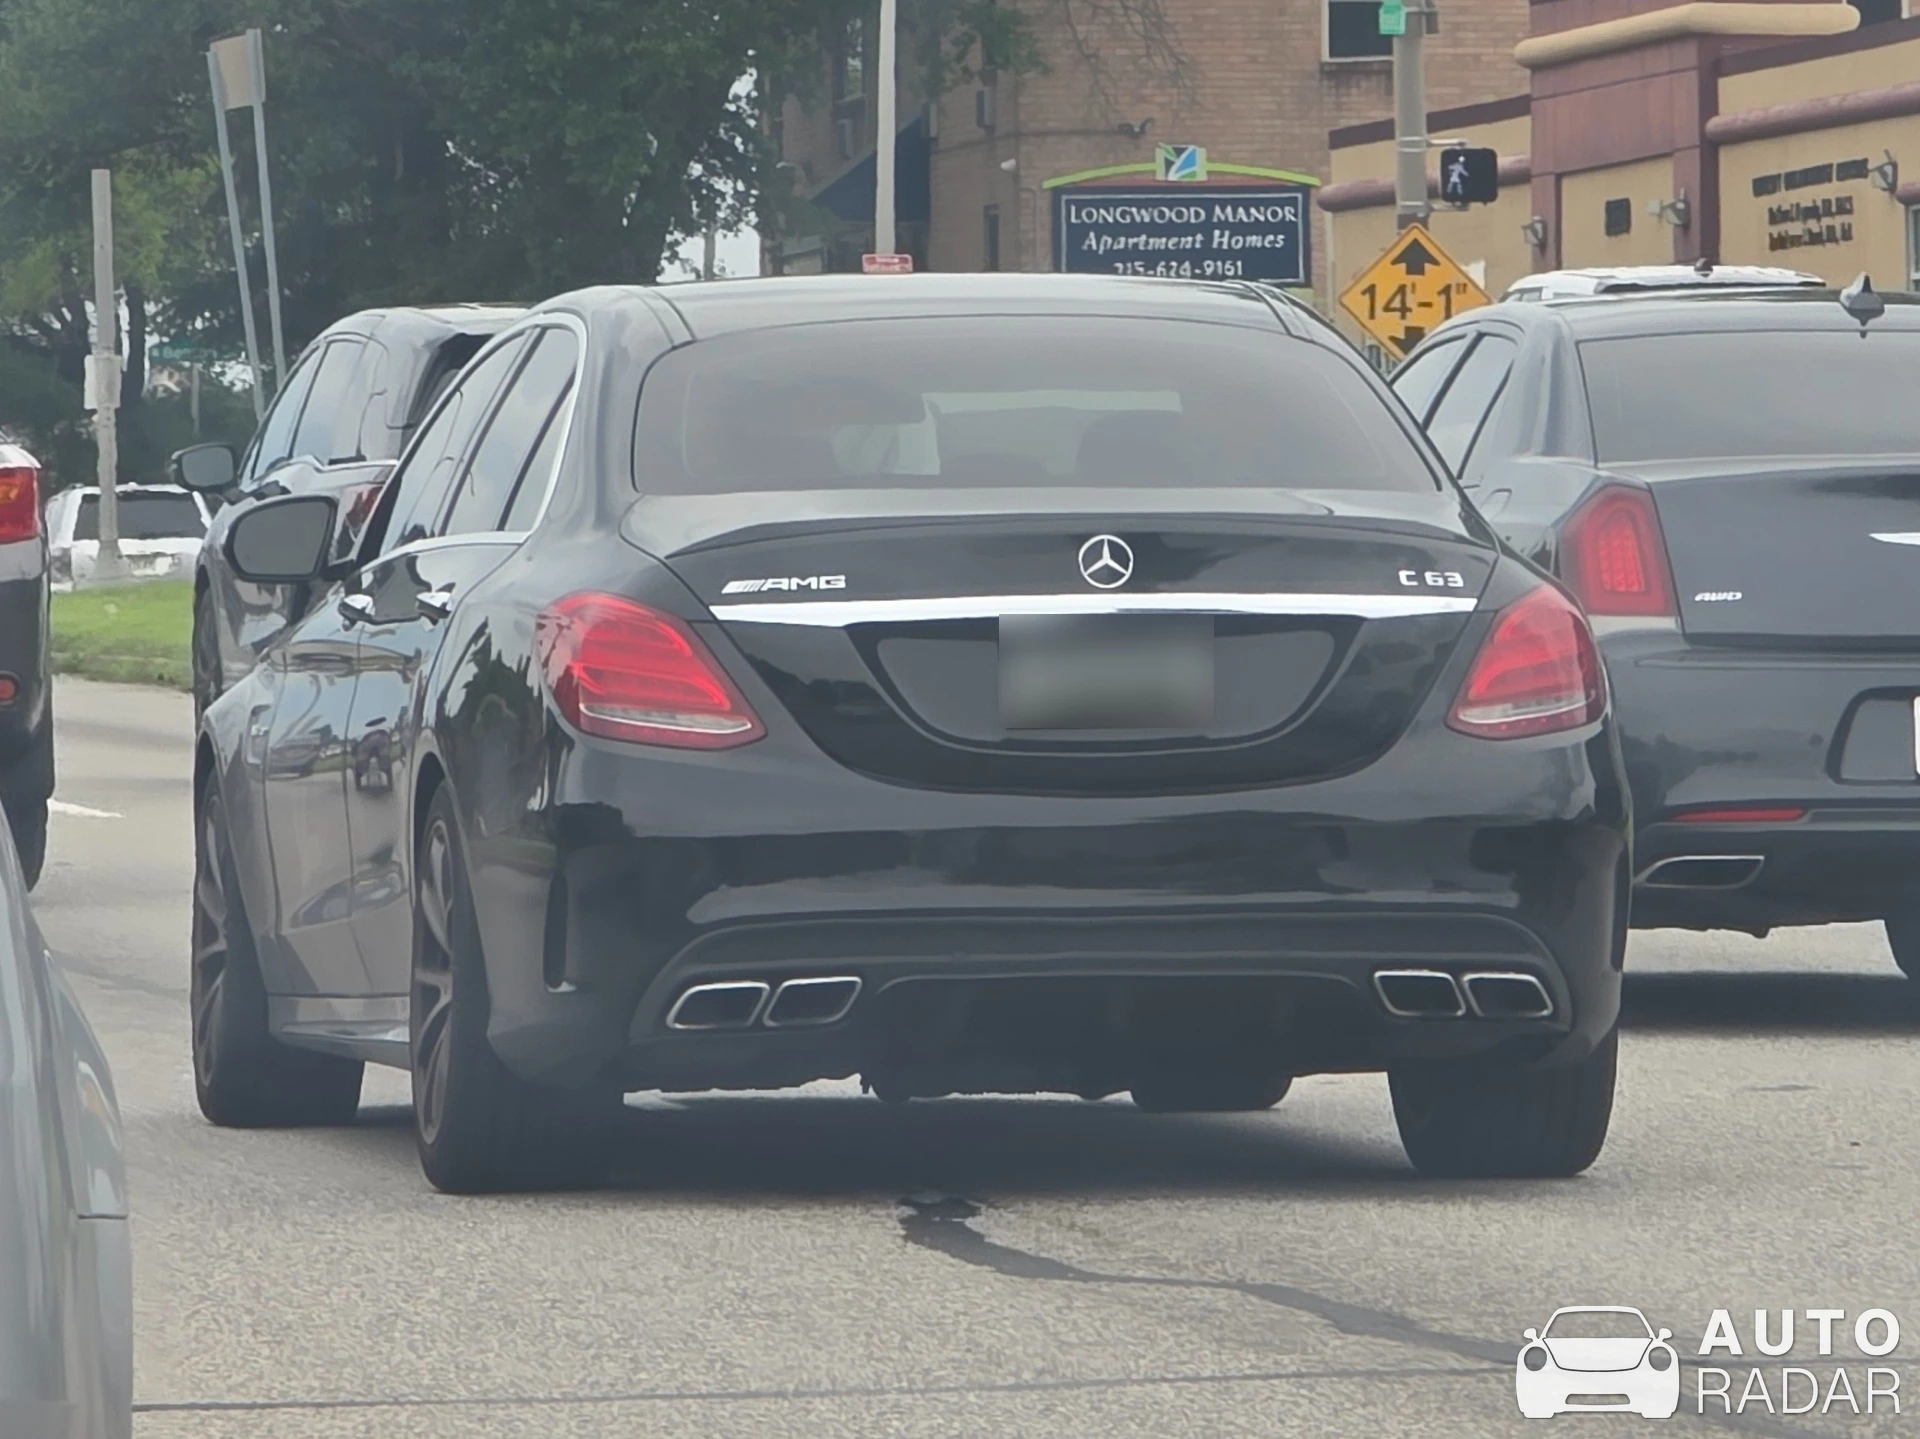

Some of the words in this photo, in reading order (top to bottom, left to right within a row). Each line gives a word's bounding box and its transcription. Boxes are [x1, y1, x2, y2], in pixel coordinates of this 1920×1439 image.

[1069, 204, 1206, 224] LONGWOOD
[1212, 204, 1299, 223] MANOR
[1081, 231, 1205, 255] Apartment
[1212, 230, 1286, 250] Homes
[760, 575, 847, 592] AMG
[1398, 569, 1419, 586] C
[1424, 570, 1465, 588] 63
[1694, 591, 1743, 602] AWD
